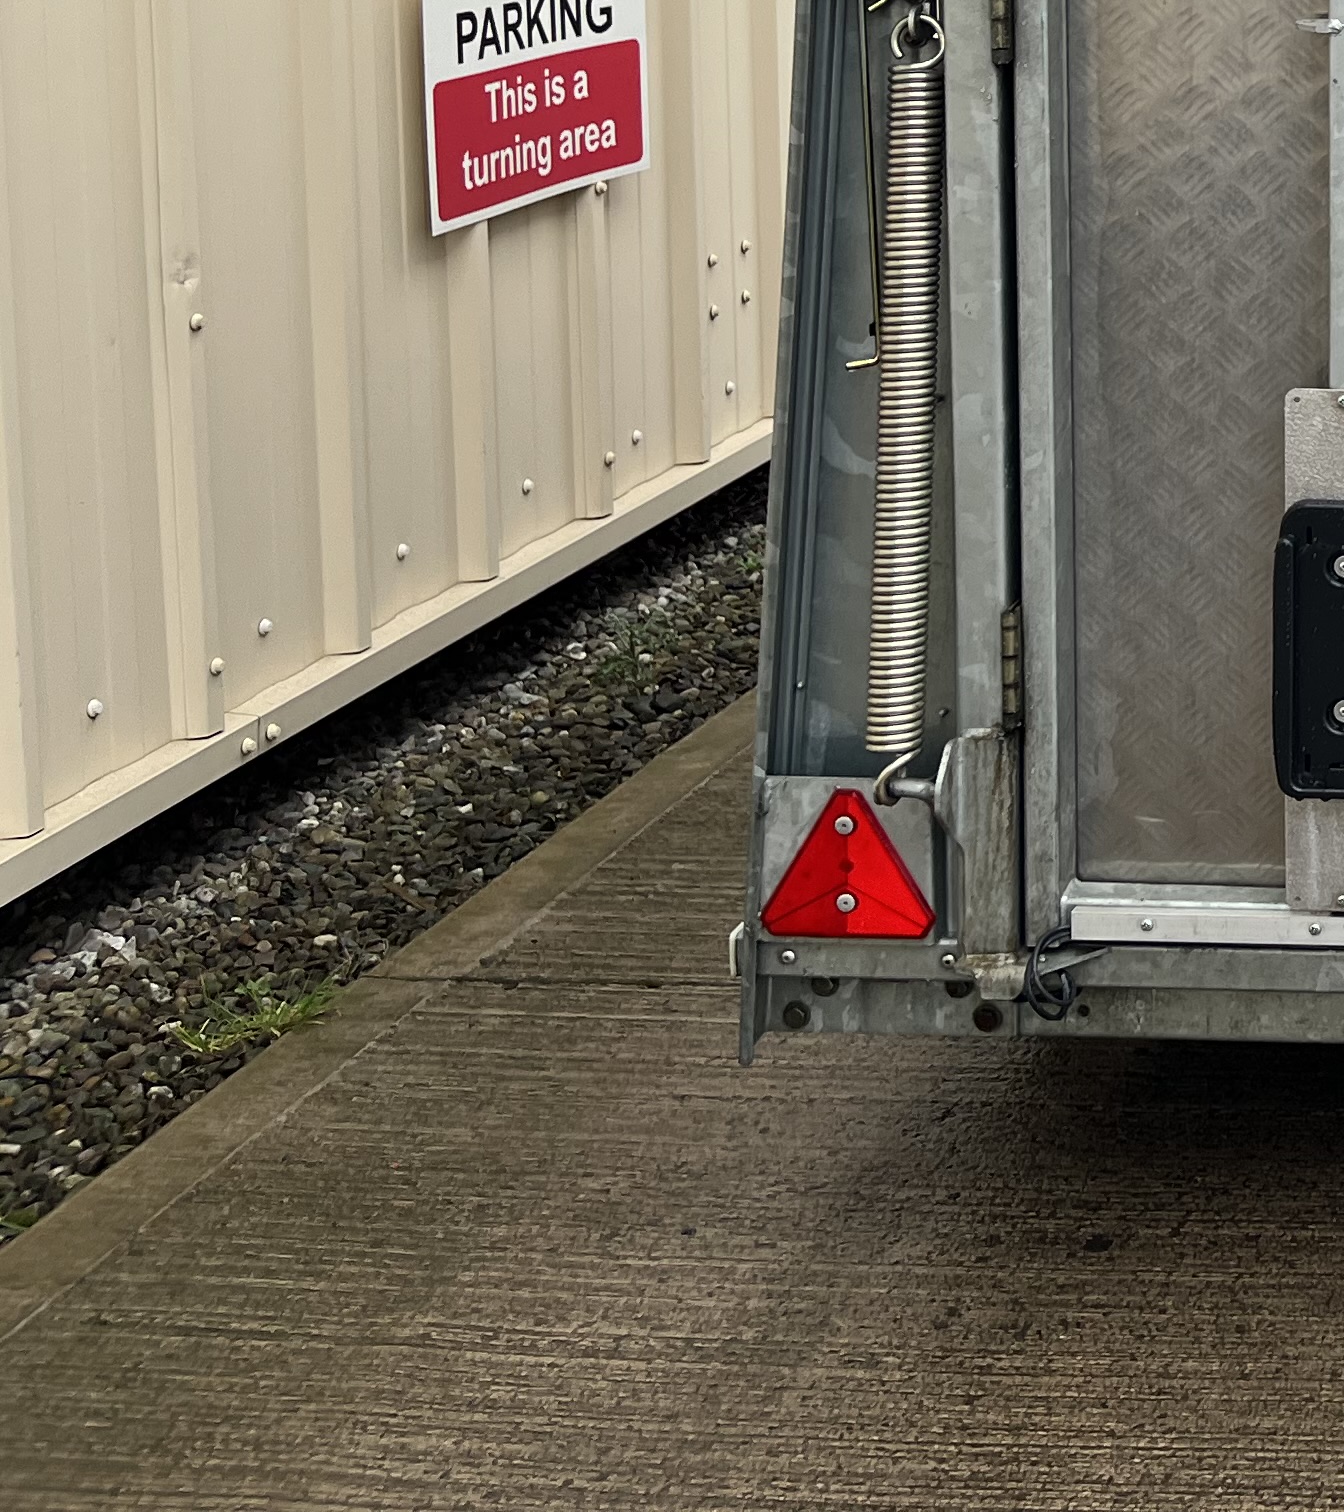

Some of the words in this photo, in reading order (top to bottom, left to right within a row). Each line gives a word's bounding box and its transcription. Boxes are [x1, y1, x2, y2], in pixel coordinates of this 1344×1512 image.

[485, 75, 537, 122] This
[544, 68, 565, 107] is
[573, 69, 589, 100] a
[462, 134, 552, 191] turning
[559, 119, 617, 160] area
